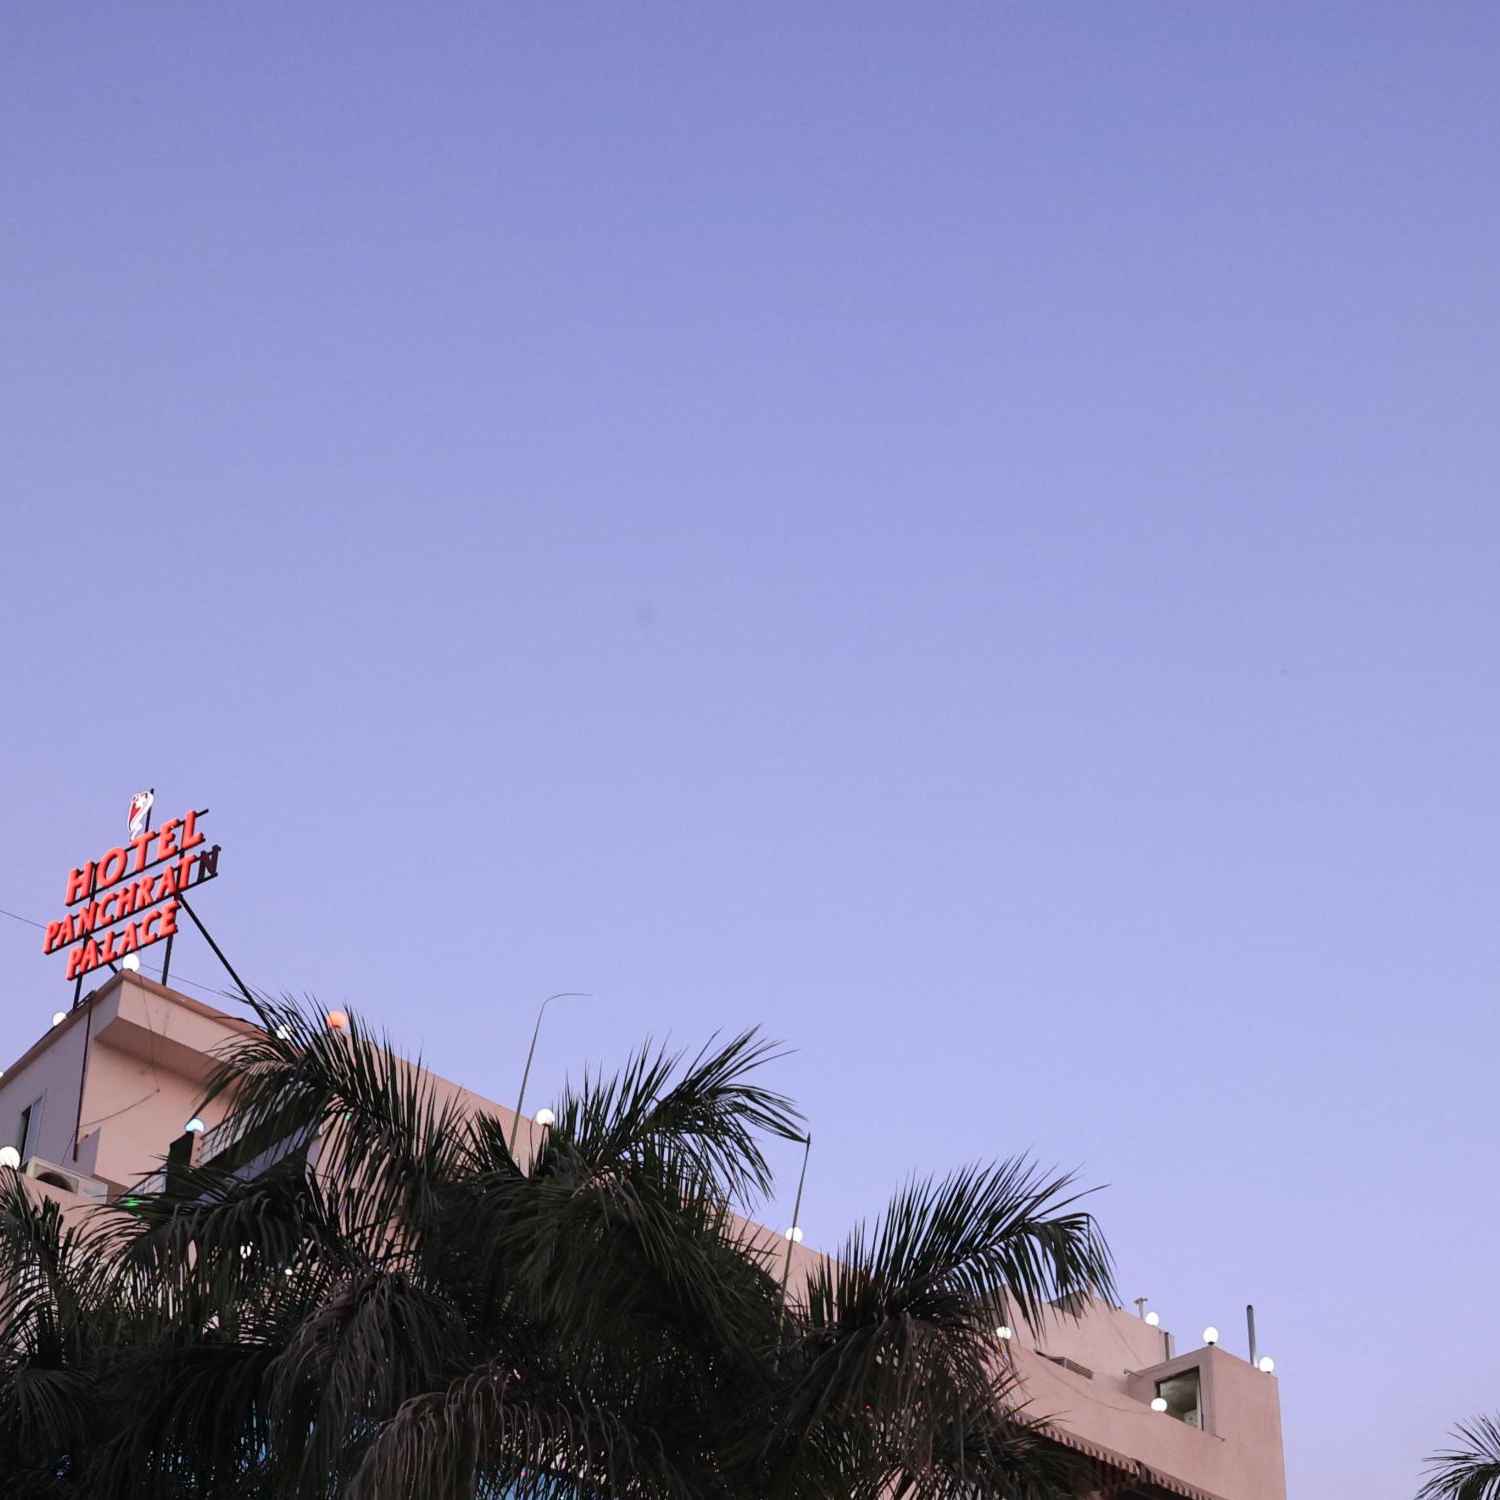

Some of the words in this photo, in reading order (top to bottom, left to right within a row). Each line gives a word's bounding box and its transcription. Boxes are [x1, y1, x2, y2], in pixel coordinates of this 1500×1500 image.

[44, 845, 221, 955] PANCHRATN
[65, 811, 206, 906] HOTEL
[67, 901, 180, 980] PALACE
